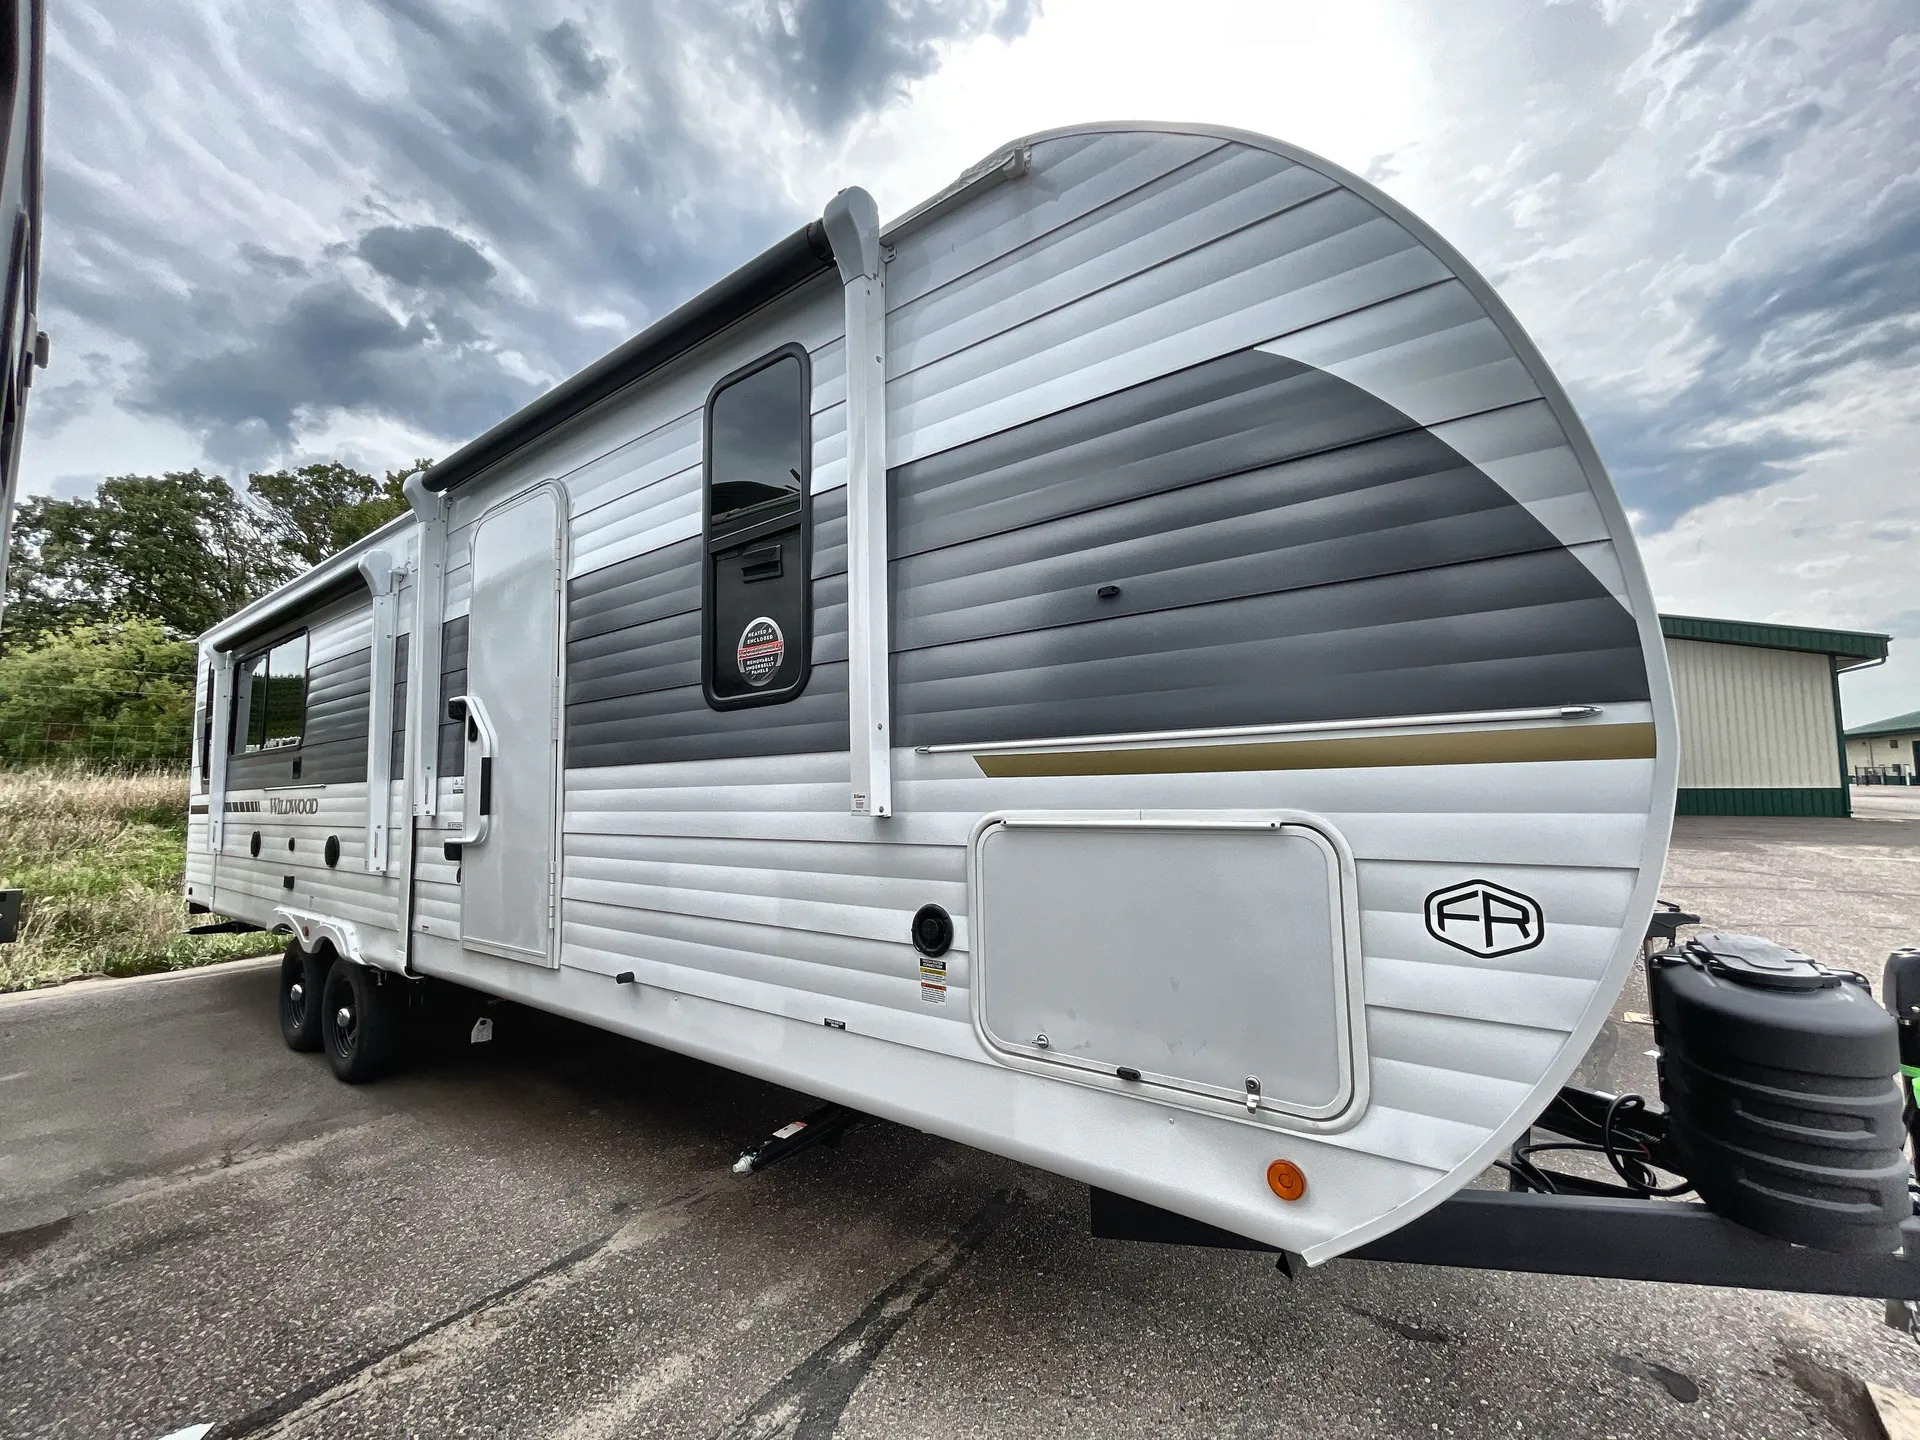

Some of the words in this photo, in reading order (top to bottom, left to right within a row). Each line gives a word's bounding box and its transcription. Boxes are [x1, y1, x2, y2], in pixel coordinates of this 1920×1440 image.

[747, 635, 773, 644] ENCLOSED
[747, 656, 773, 665] REMOVABLE
[745, 661, 774, 671] UNDERBELLY
[1436, 889, 1531, 949] FR
